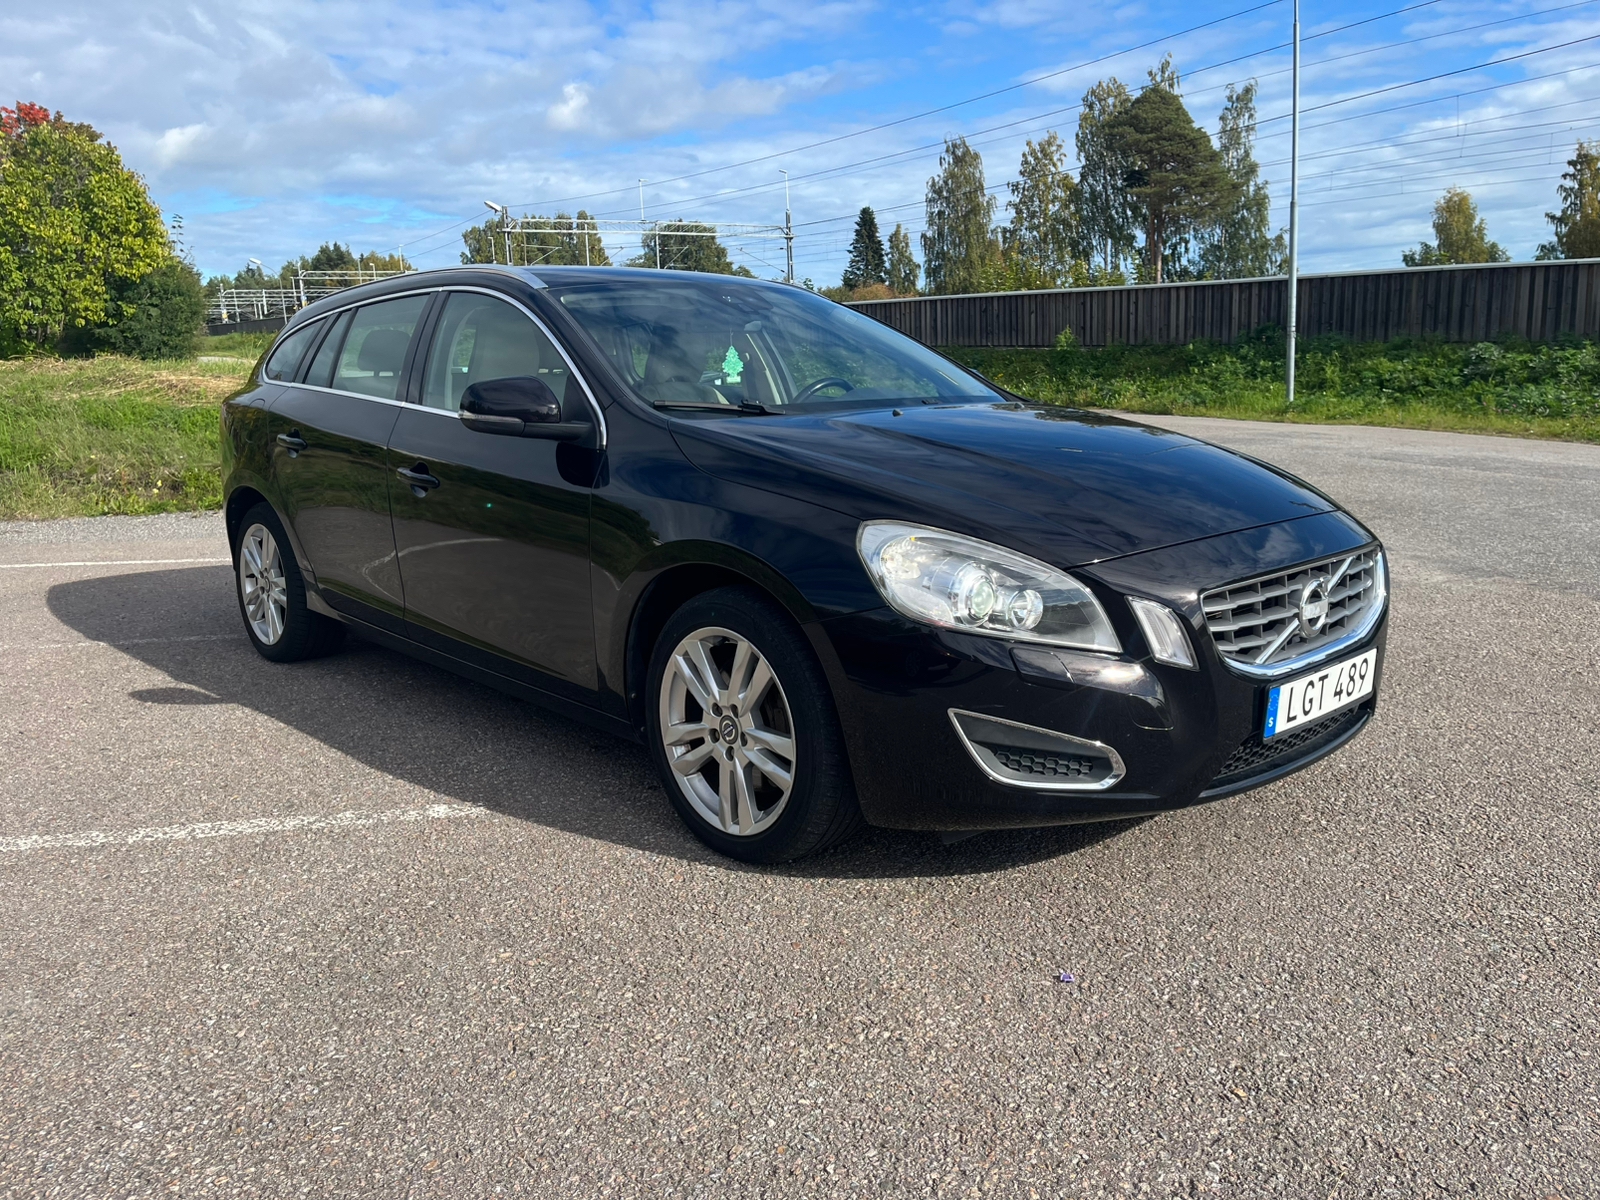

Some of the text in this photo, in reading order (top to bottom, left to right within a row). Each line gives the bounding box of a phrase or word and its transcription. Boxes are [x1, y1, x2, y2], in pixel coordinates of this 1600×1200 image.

[1286, 658, 1369, 723] LGT 489
[1268, 717, 1274, 727] S
